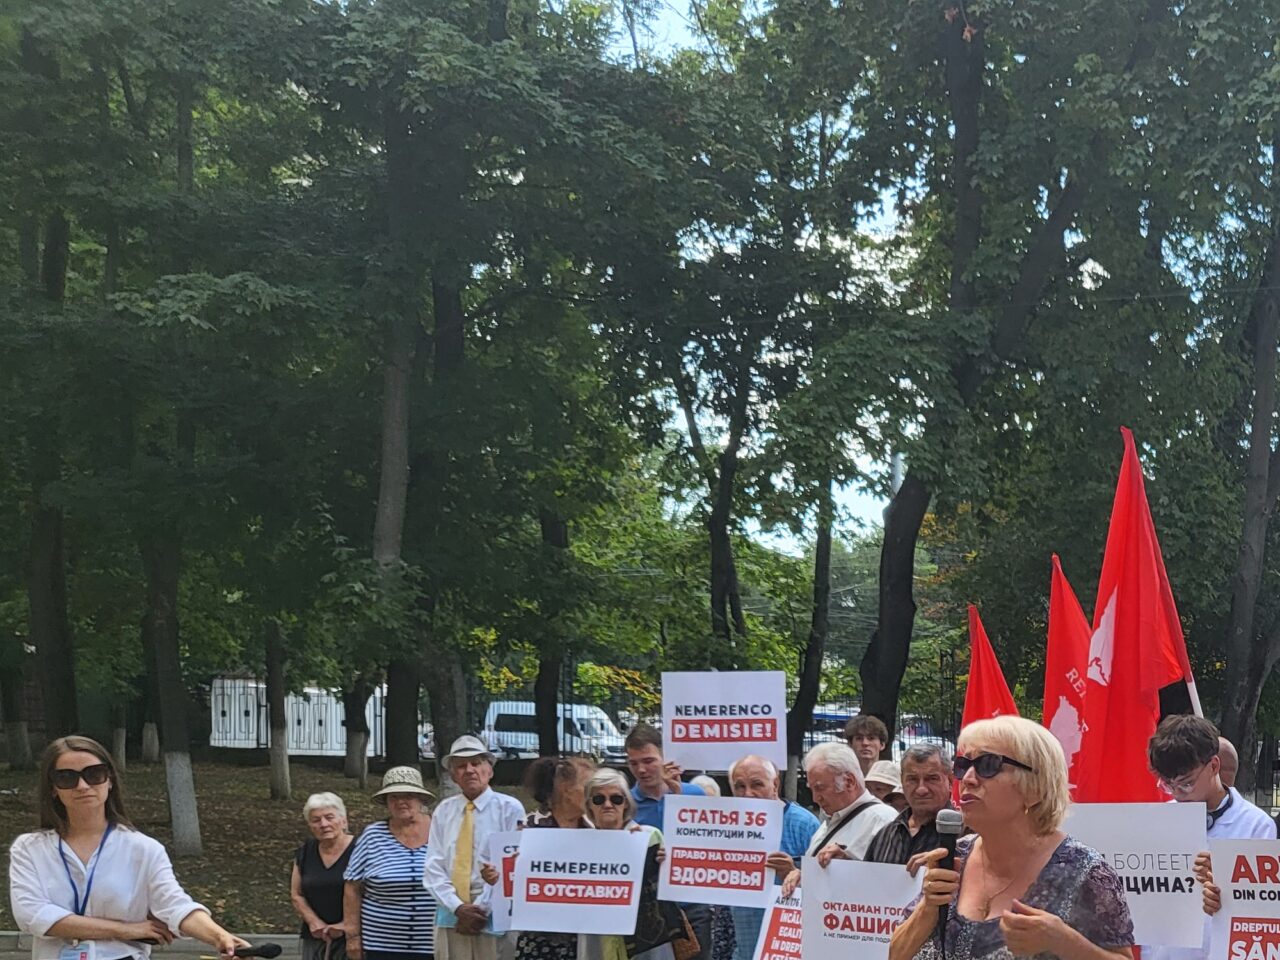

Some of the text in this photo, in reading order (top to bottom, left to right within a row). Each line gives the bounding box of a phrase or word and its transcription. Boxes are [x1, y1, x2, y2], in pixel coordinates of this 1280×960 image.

[675, 704, 772, 717] NEMERENCO
[674, 723, 772, 739] DEMISIE!
[677, 808, 768, 827] СТАТЬЯ 36
[676, 827, 765, 840] КОНСТИТУЦИИ РМ.
[673, 849, 764, 864] ПРАВО НА ОХРАНУ
[1114, 853, 1193, 871] БОЛЕЕТ
[530, 860, 631, 876] НЕМЕРЕНКО
[671, 866, 762, 887] ЗДОРОВЬЯ
[528, 882, 629, 899] В ОТСТАВКУ!
[1233, 889, 1256, 901] DIN
[823, 901, 881, 915] ОКТАВИАН
